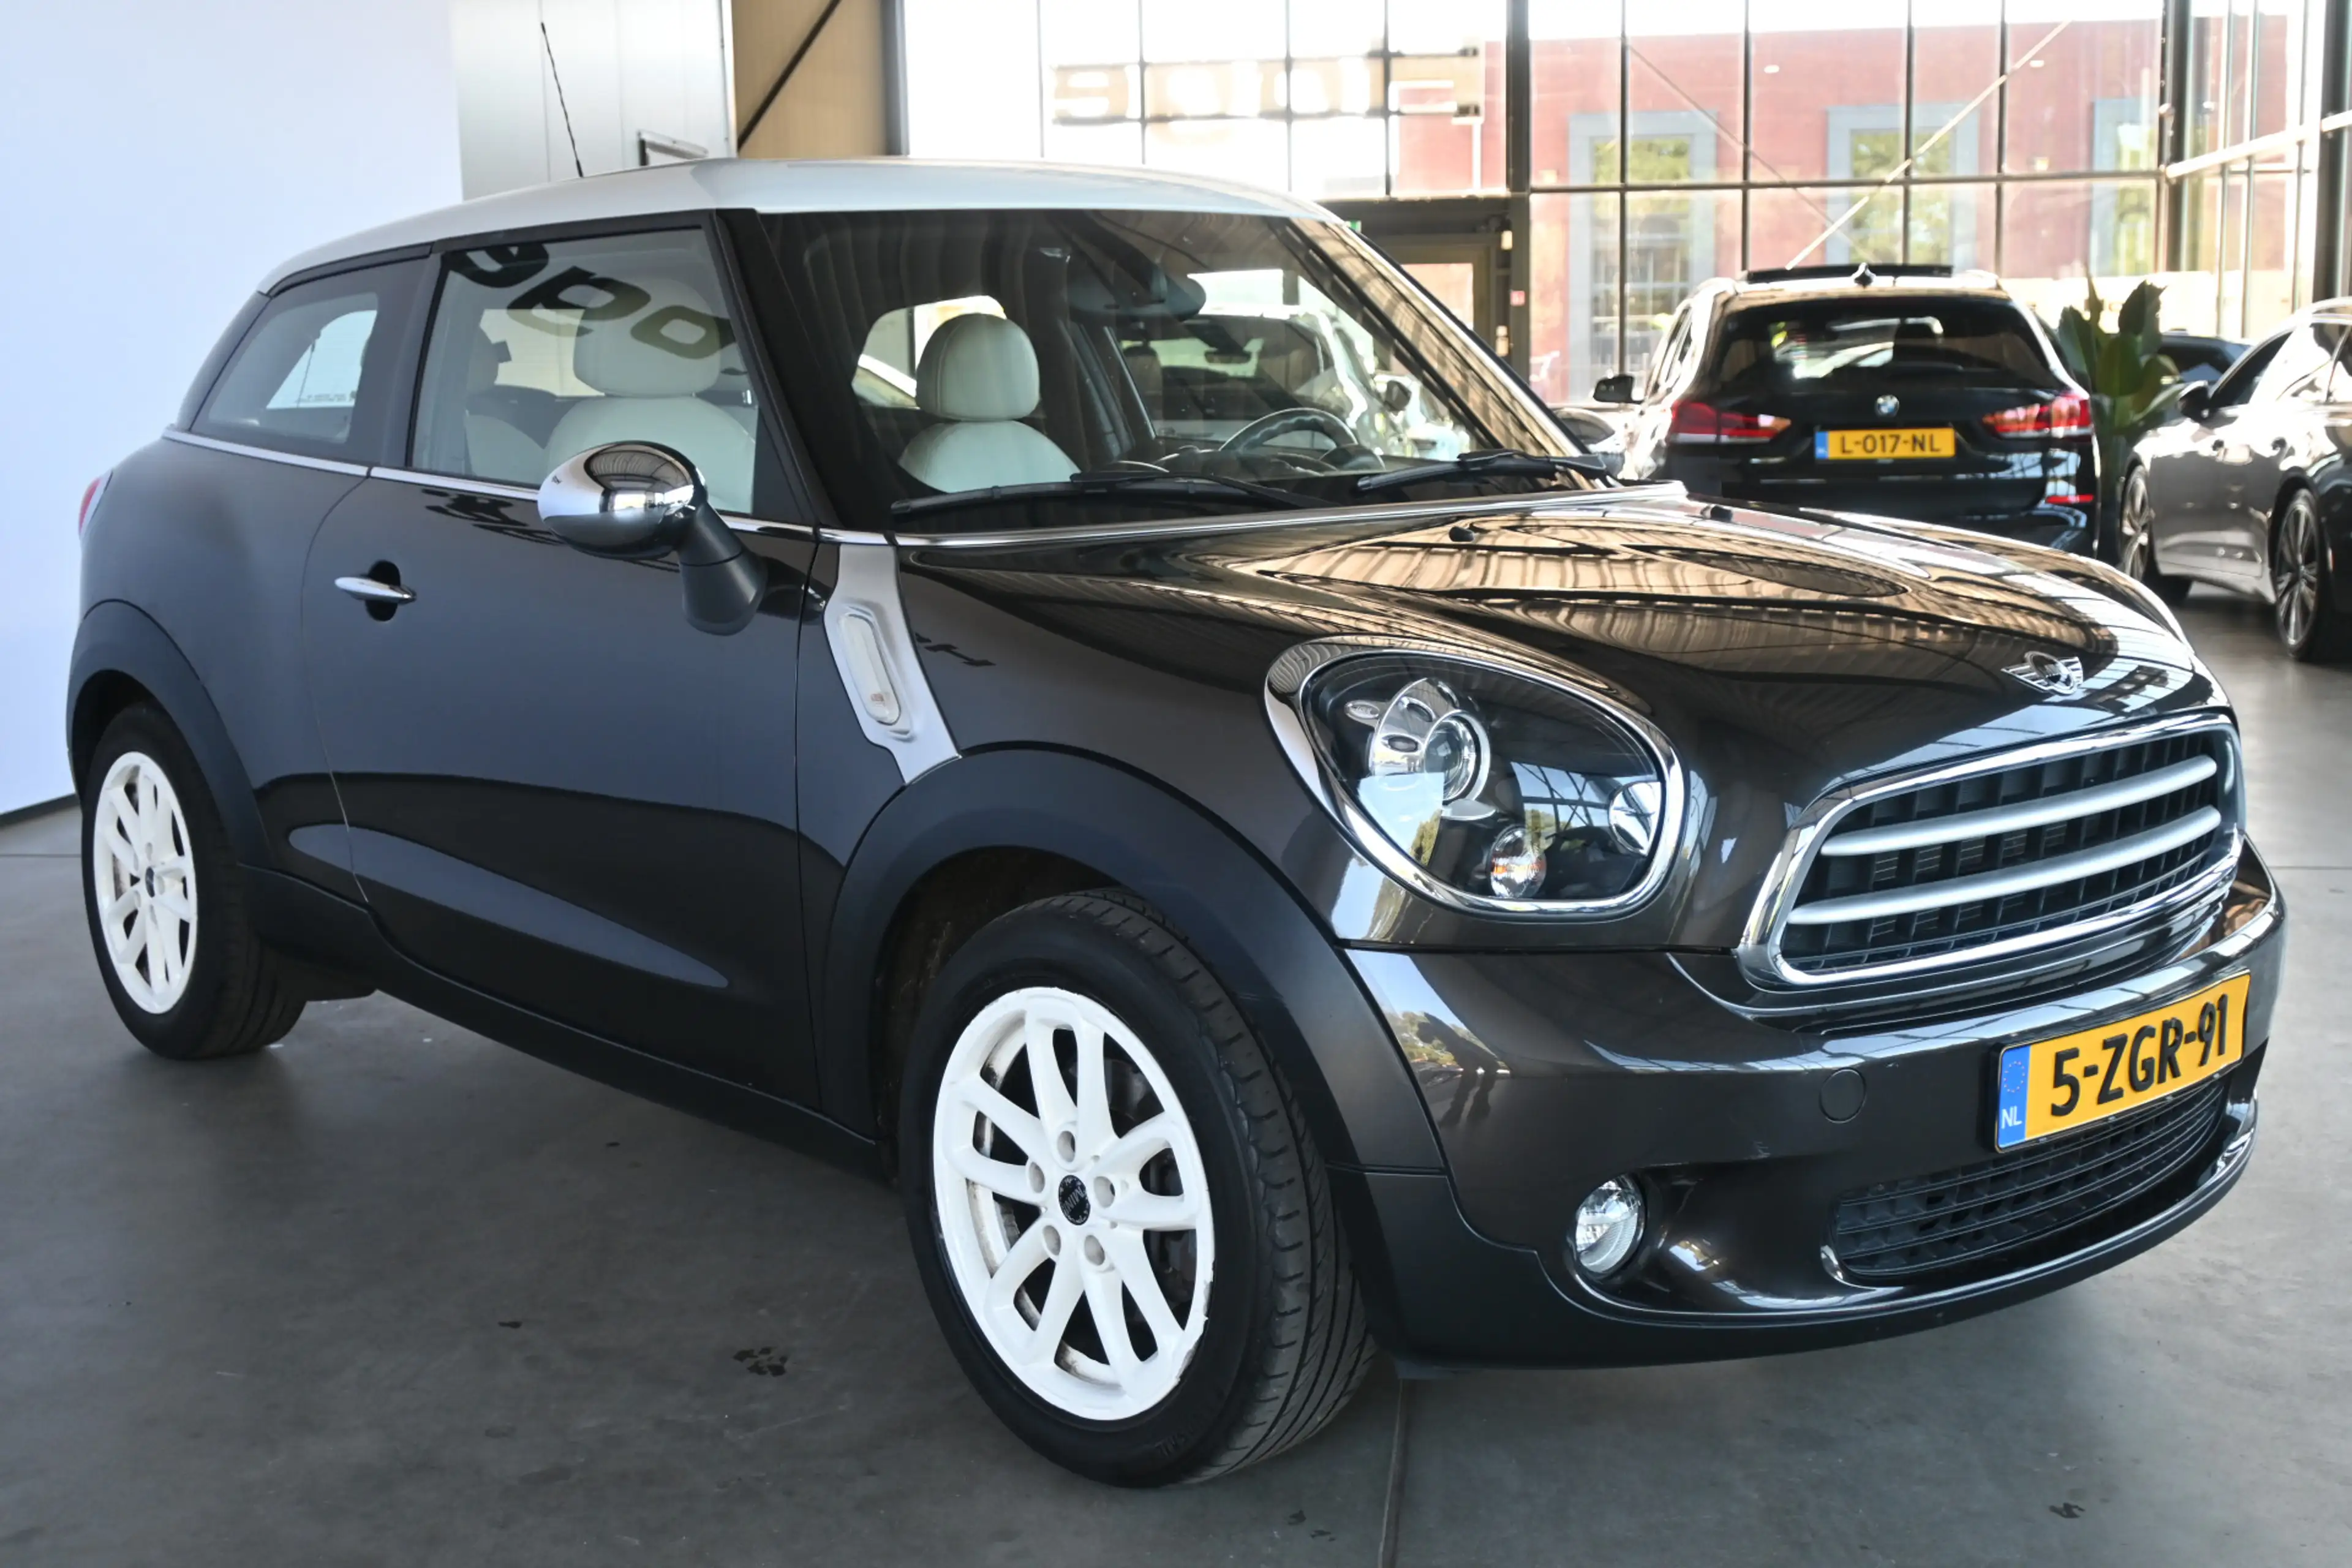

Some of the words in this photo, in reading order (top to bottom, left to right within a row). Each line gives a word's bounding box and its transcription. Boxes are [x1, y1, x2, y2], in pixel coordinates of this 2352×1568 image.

[1840, 433, 1941, 454] L-017-NL
[2051, 993, 2228, 1117] 5-ZGR-91
[2001, 1105, 2022, 1129] NL
